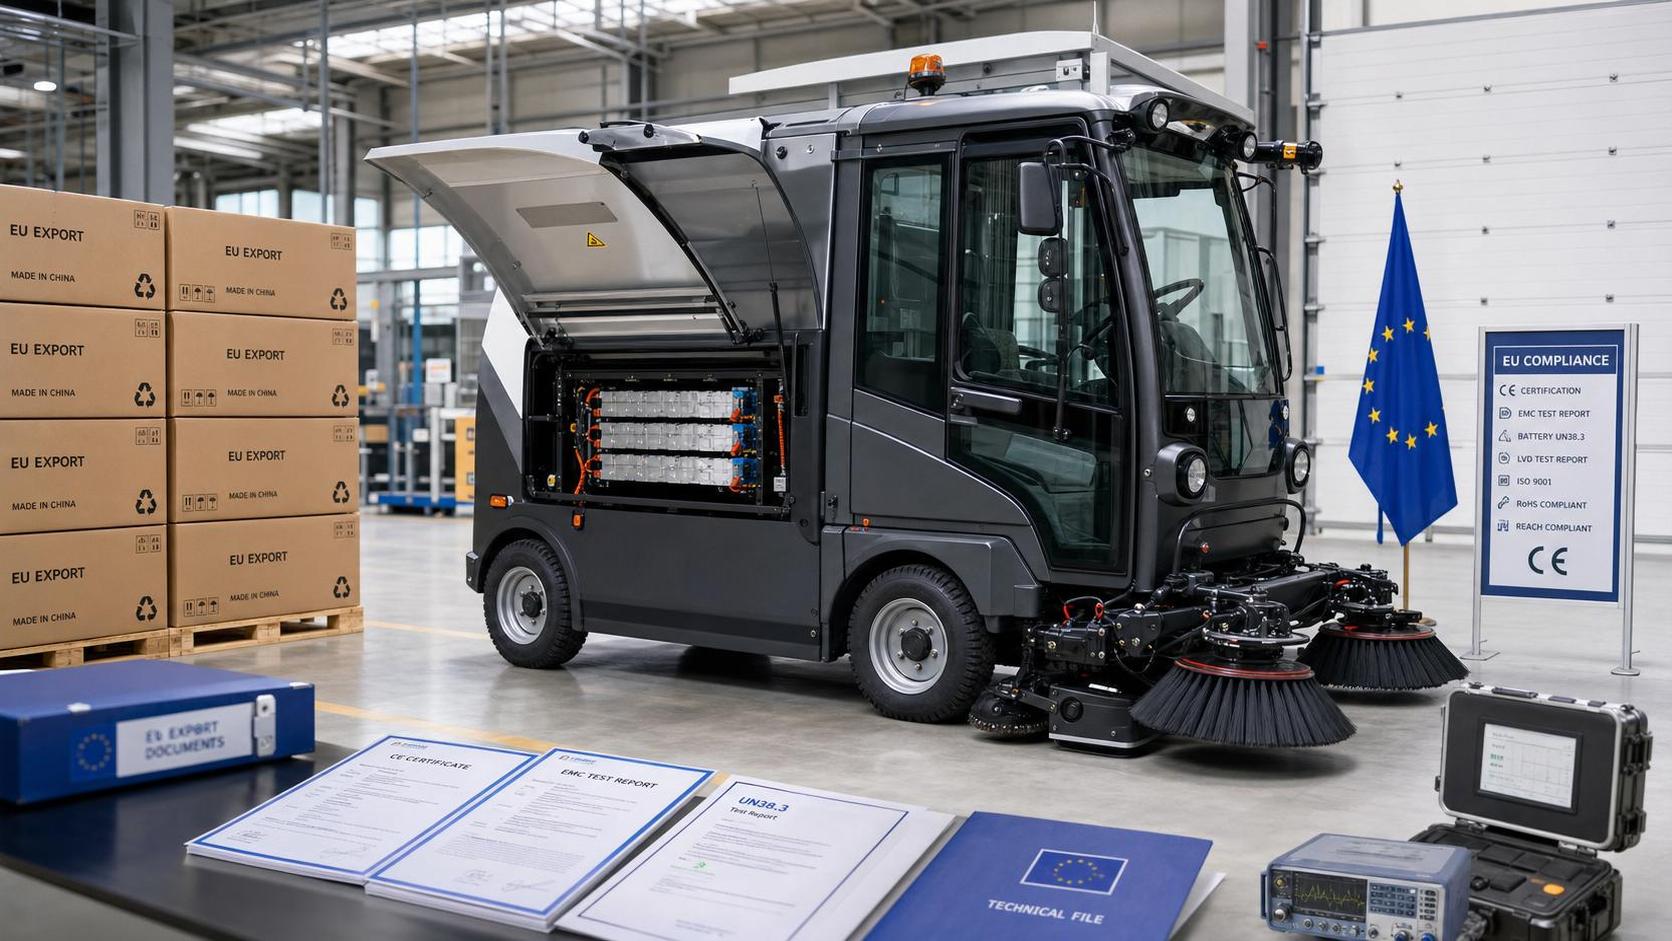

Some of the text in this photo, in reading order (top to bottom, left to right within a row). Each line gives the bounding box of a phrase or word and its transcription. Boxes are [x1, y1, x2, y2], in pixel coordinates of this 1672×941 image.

[10, 224, 85, 242] EU EXPORT
[225, 245, 282, 261] EU EXPORT
[11, 271, 76, 283] MADE IN CHINA
[226, 286, 276, 297] MADE IN CHINA
[10, 343, 85, 357] EU EXPORT
[226, 348, 286, 361] EU EXPORT
[1503, 355, 1609, 367] EU COMPLIANCE
[11, 388, 76, 397] MADE IN CHINA
[227, 389, 277, 397] MADE IN CHINA
[1499, 384, 1581, 397] CE CERTIFICATION
[1518, 409, 1536, 418] EMC
[1517, 432, 1585, 441] BATTERY UN38.3
[10, 455, 85, 469] EU EXPORT
[228, 450, 286, 462] EU EXPORT
[1517, 455, 1533, 463] LVD
[1556, 456, 1588, 464] REPORT
[1517, 477, 1552, 486] ISO 9001
[229, 490, 278, 500] MADE IN CHINA
[12, 500, 76, 511] MADE IN CHINA
[1516, 500, 1587, 509] RoHS COMPLIANT
[1515, 523, 1592, 532] REACH COMPLIANT
[229, 551, 288, 566] EU EXPORT
[1528, 546, 1568, 576] CE
[11, 567, 85, 584] EU EXPORT
[230, 589, 280, 601] MADE IN CHINA
[12, 612, 77, 626] MADE IN CHINA
[145, 736, 225, 759] DOCUMENTS
[406, 755, 472, 770] CERTIFICATE
[561, 769, 658, 789] EMC TEST REPORT
[738, 796, 789, 812] UN38.3
[748, 810, 778, 820] Report
[988, 899, 1105, 924] TECHNICAL FILE
